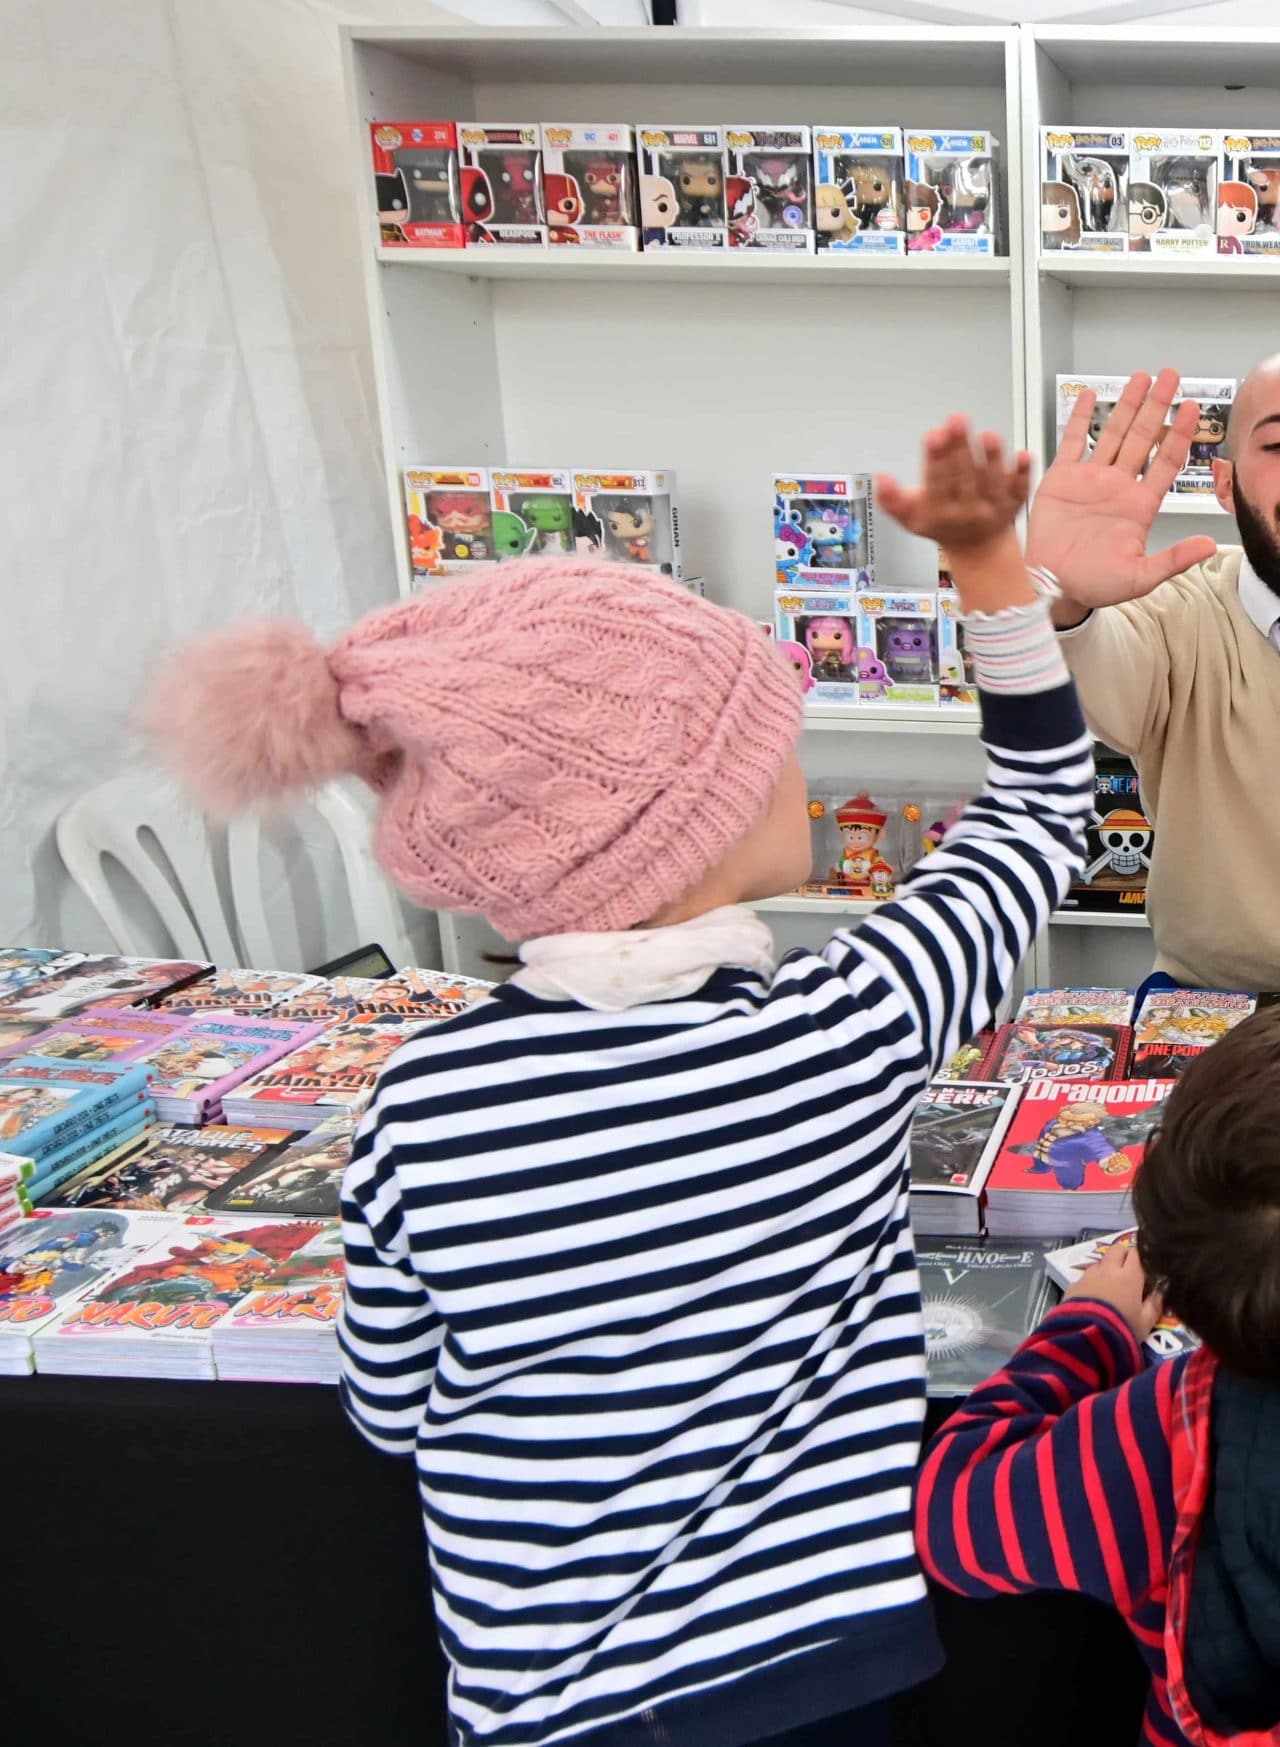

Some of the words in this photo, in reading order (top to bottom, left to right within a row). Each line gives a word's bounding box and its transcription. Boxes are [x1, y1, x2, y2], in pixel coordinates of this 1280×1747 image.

[673, 133, 698, 145] MARVEL
[1046, 134, 1075, 150] POP!
[1111, 136, 1123, 147] 03
[1135, 135, 1162, 151] POP!
[1225, 137, 1253, 154] POP!
[500, 229, 537, 238] DEADPOOL
[584, 231, 597, 240] THE
[599, 231, 622, 241] FLASH
[672, 232, 711, 242] PROFESSOR
[713, 233, 721, 242] X
[1155, 239, 1180, 247] HARRY
[1181, 239, 1208, 247] POTTER
[1246, 241, 1259, 249] RON
[833, 482, 845, 493] 41
[1176, 481, 1199, 489] HARRY
[671, 507, 681, 548] GOHAN
[943, 1268, 969, 1286] V
[65, 1301, 230, 1330] NARUTO
